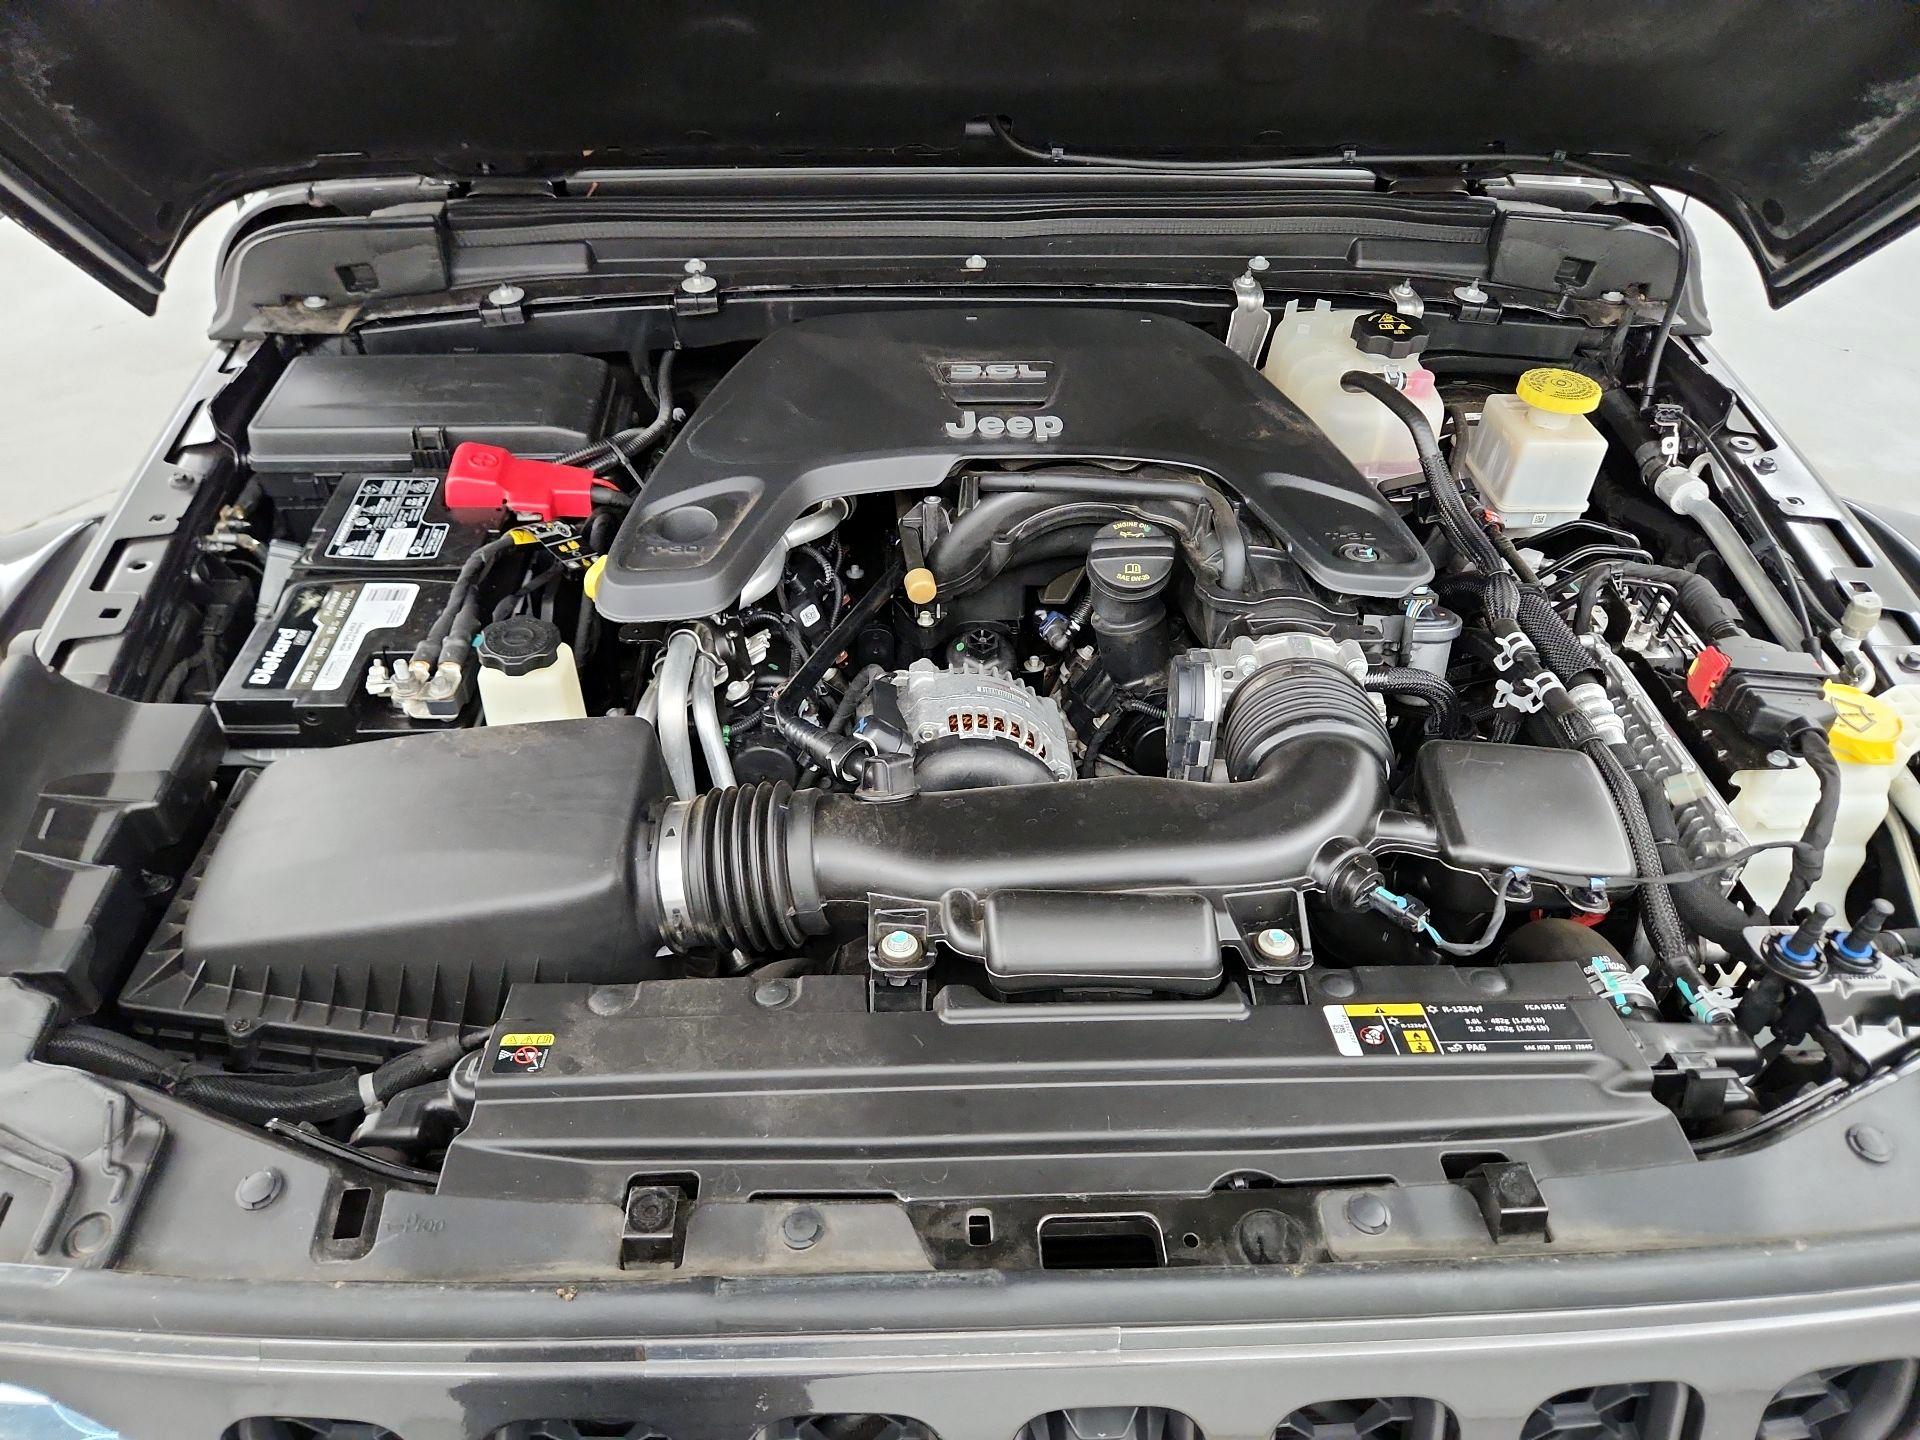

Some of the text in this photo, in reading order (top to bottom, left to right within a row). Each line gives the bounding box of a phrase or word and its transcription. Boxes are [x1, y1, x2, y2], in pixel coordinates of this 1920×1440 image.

[945, 411, 1064, 441] Jeep
[1112, 521, 1139, 530] ENGINE
[1116, 573, 1130, 581] SAE
[248, 628, 299, 685] DieHard
[1441, 1005, 1483, 1014] R-1234yf
